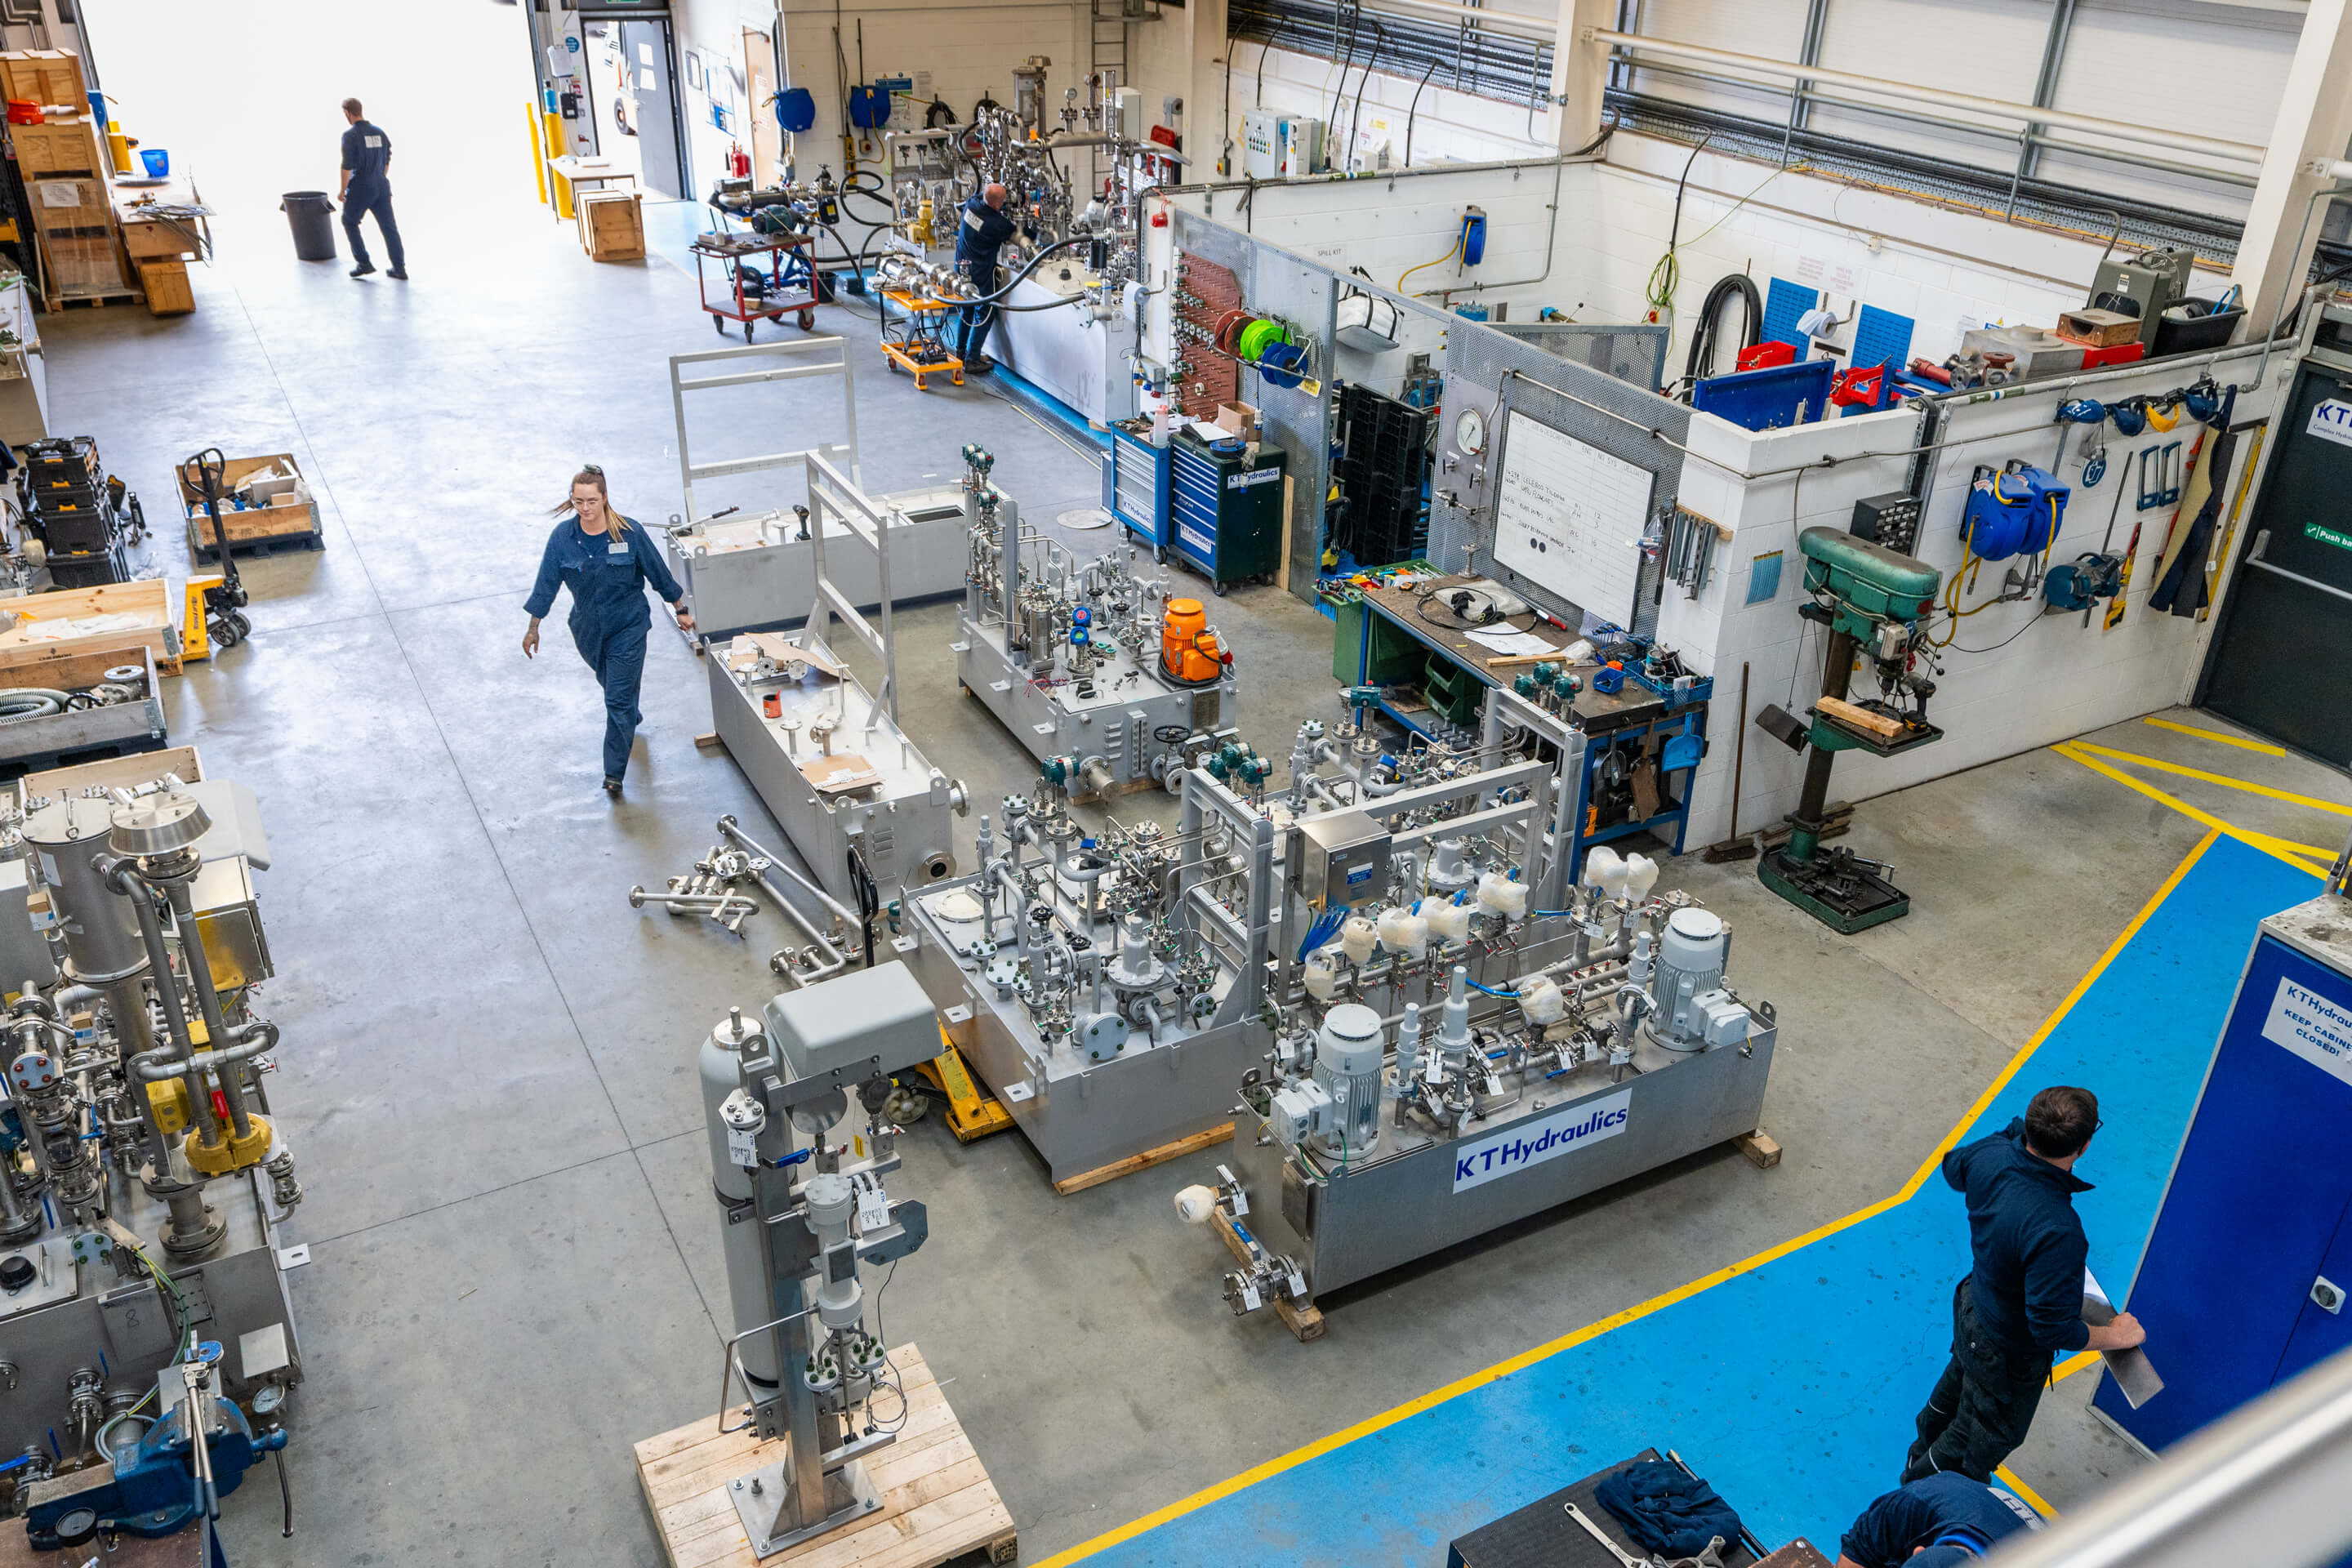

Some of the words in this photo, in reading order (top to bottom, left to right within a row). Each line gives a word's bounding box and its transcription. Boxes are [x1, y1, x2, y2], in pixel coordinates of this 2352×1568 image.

[2314, 425, 2335, 434] Complex
[1229, 468, 1278, 484] KTydraulics
[1124, 501, 1152, 525] KTHydraulics
[1182, 523, 1211, 548] KTHydraulics
[2320, 530, 2341, 543] Push
[2284, 1009, 2311, 1026] KEEP
[2296, 1028, 2340, 1057] CLOSED!
[1456, 1108, 1628, 1182] KTHydraulics
